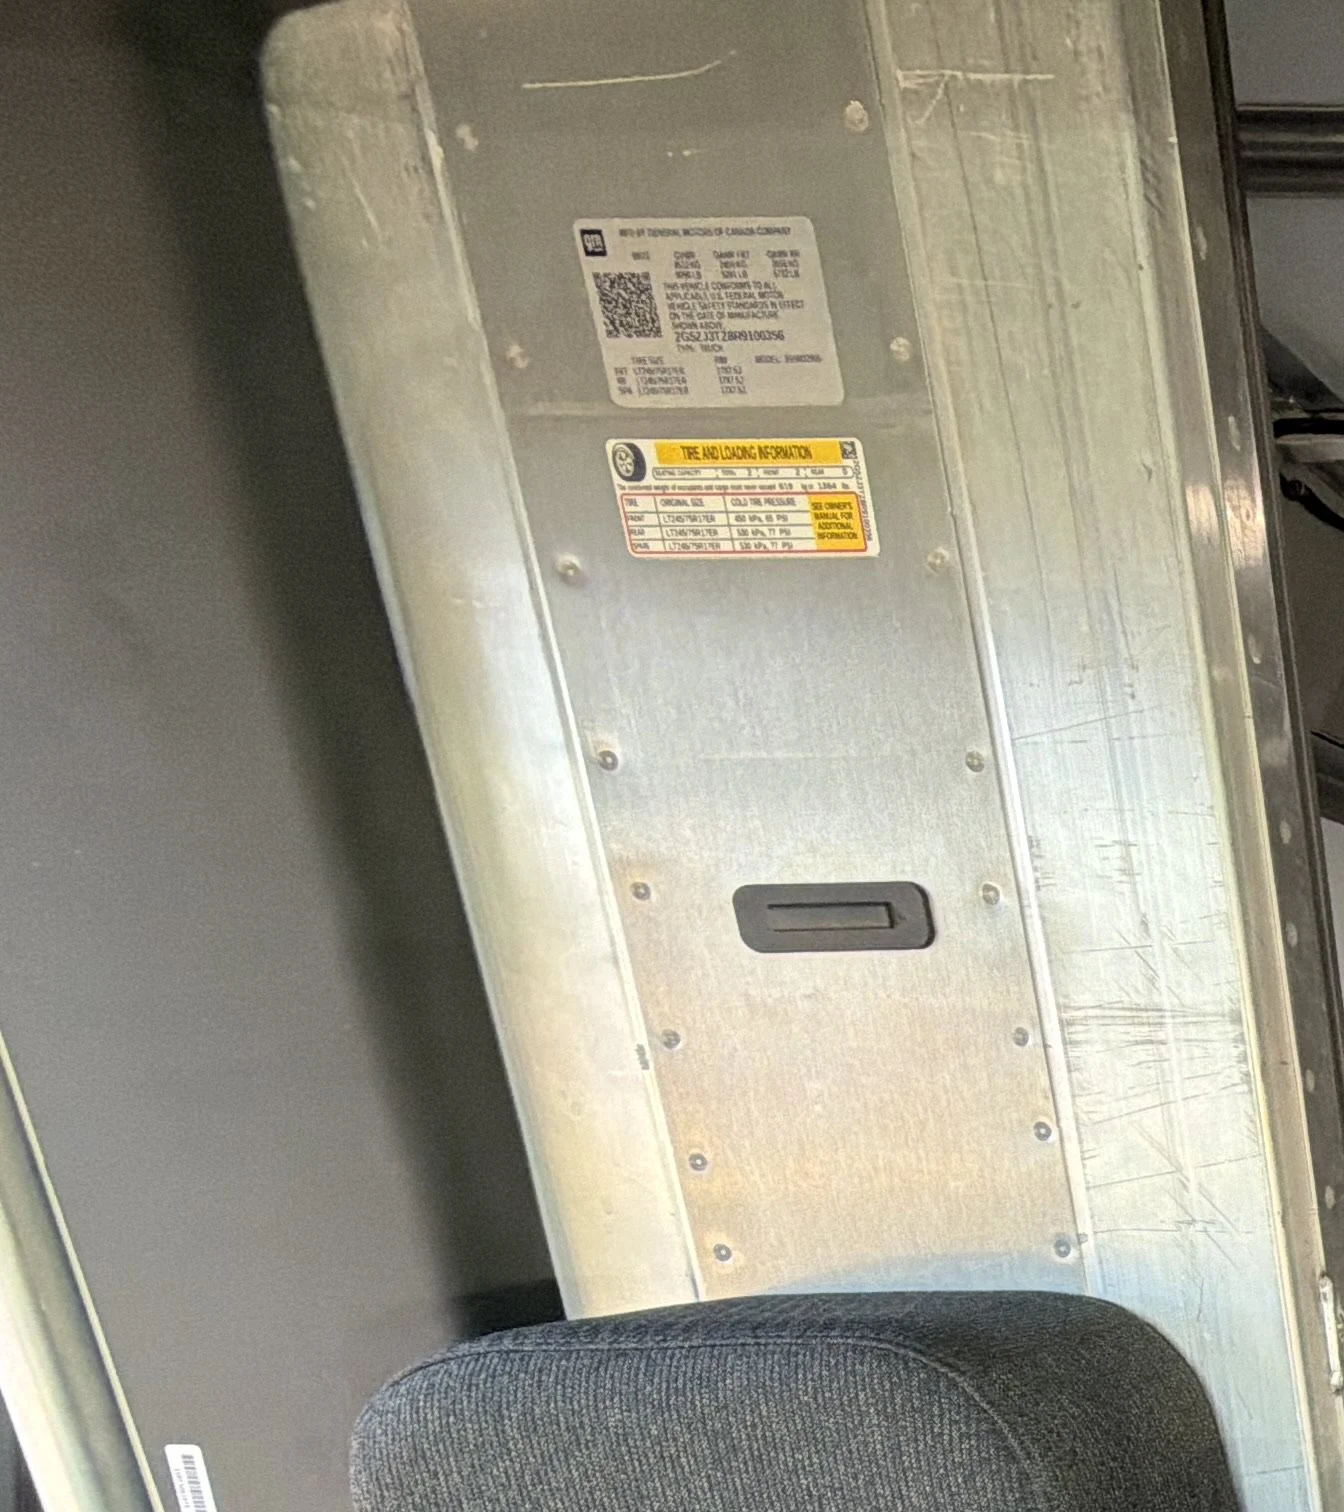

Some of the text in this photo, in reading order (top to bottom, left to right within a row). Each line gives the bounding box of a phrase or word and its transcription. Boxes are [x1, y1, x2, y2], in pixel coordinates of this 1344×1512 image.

[680, 282, 709, 291] VEHICLE
[752, 282, 762, 291] TO
[726, 291, 756, 301] FEDERAL
[699, 301, 725, 311] SAFETY
[727, 301, 769, 311] STANDARDS
[779, 300, 804, 309] EFFECT
[669, 311, 680, 320] ON
[681, 311, 695, 320] THE
[716, 311, 725, 320] OF
[680, 445, 813, 460] TIRE AND LOADING INFORMATION
[660, 498, 704, 507] ORIGINAL SIZE
[731, 497, 796, 506] COLD TIRE PRESSURE
[811, 502, 853, 510] SEE OWNER'S
[814, 512, 853, 520] MANUAL FOR
[818, 522, 853, 530] ADDITIONAL
[817, 532, 858, 540] INFORMATION
